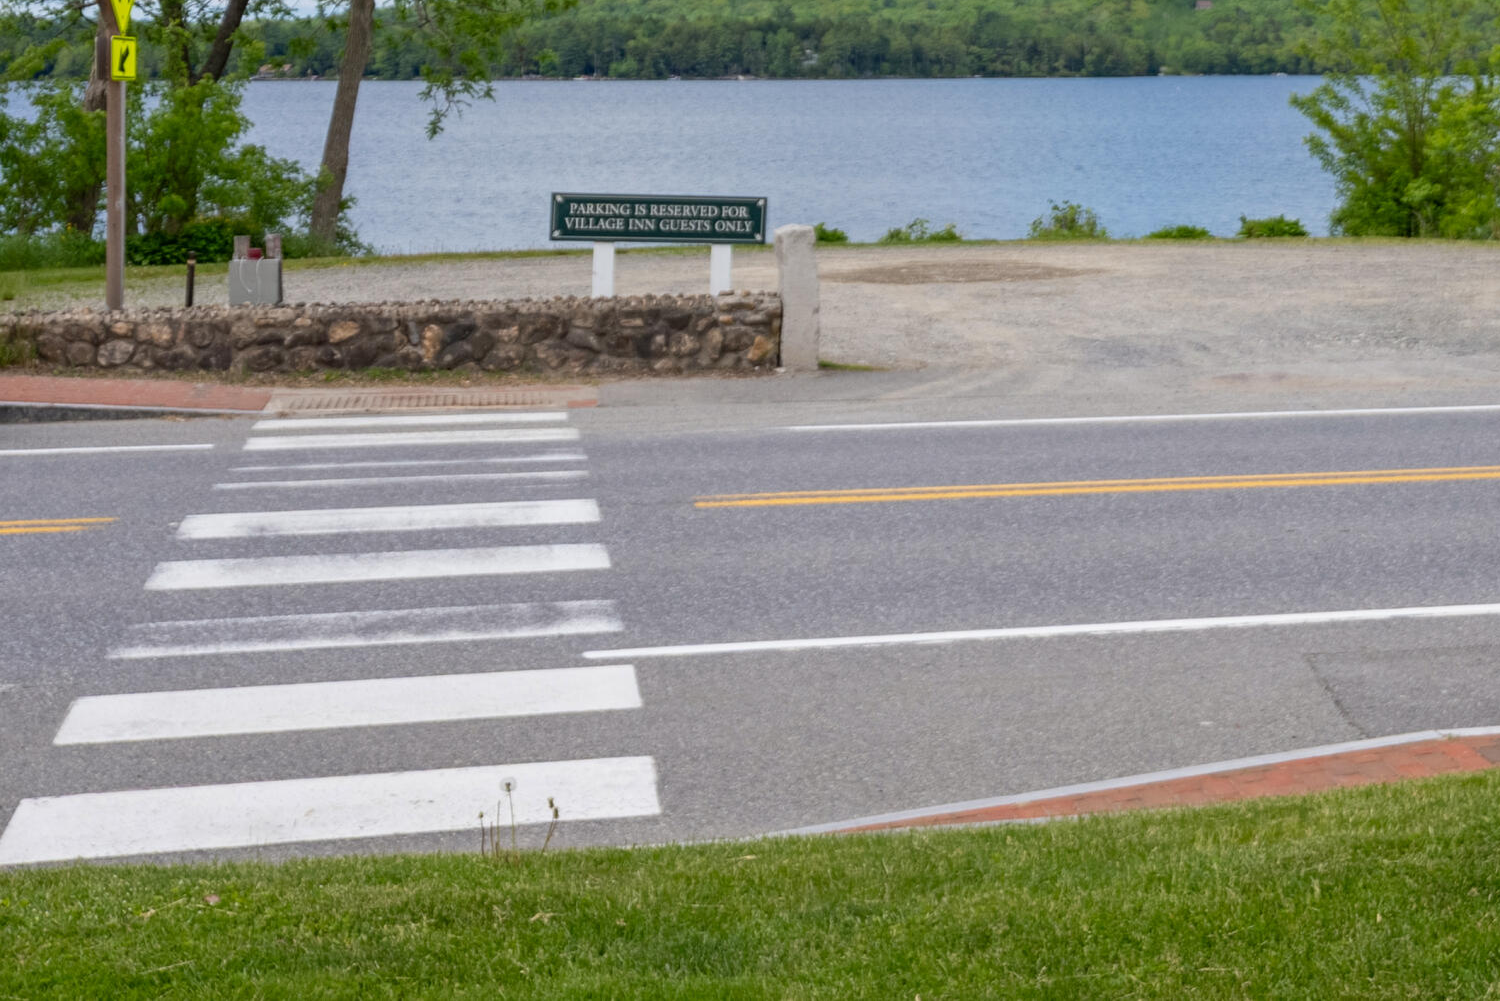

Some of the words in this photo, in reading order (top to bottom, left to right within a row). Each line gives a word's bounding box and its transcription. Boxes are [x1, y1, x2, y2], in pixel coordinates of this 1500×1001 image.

[569, 202, 630, 216] PARKING
[634, 203, 646, 216] IS
[650, 204, 718, 217] RESERVED
[721, 205, 749, 218] FOR
[564, 217, 625, 230] VILLAGE
[628, 218, 655, 231] INN
[659, 218, 711, 231] GUESTS
[714, 220, 753, 232] ONLY
